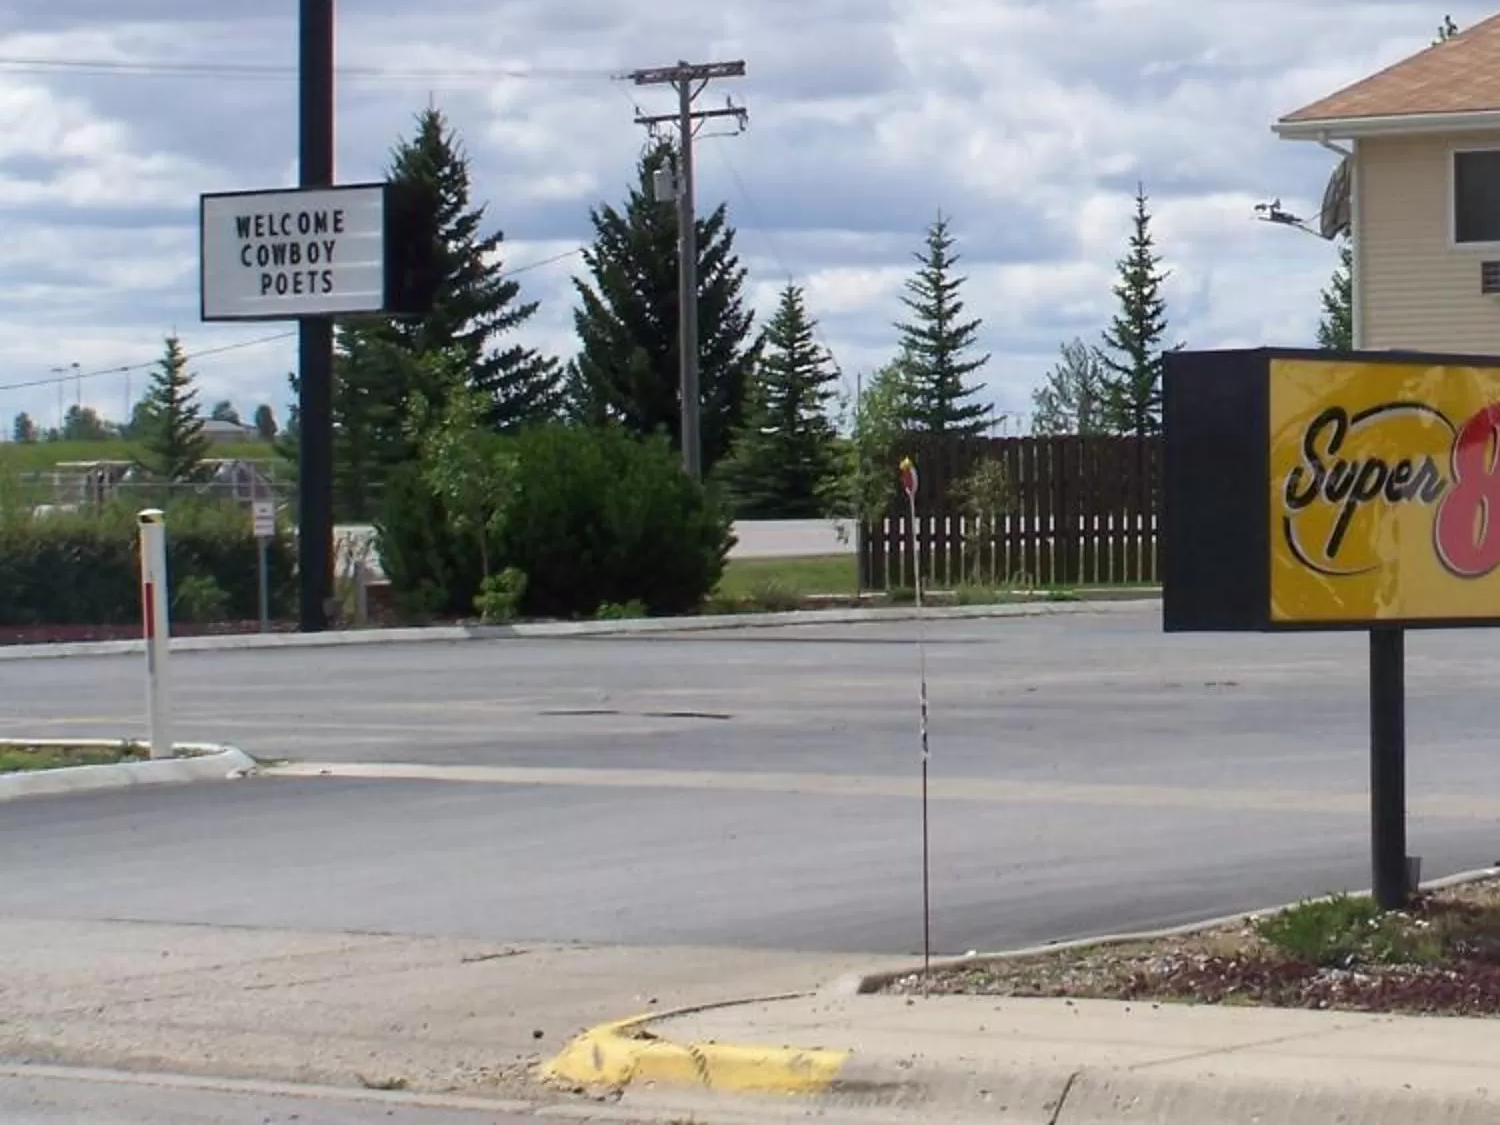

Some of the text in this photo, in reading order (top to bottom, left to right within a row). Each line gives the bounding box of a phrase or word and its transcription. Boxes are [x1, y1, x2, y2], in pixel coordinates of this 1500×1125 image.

[235, 210, 345, 239] WELCOME
[240, 239, 336, 267] COWBOY
[260, 270, 333, 295] POETS
[1285, 406, 1449, 559] Super
